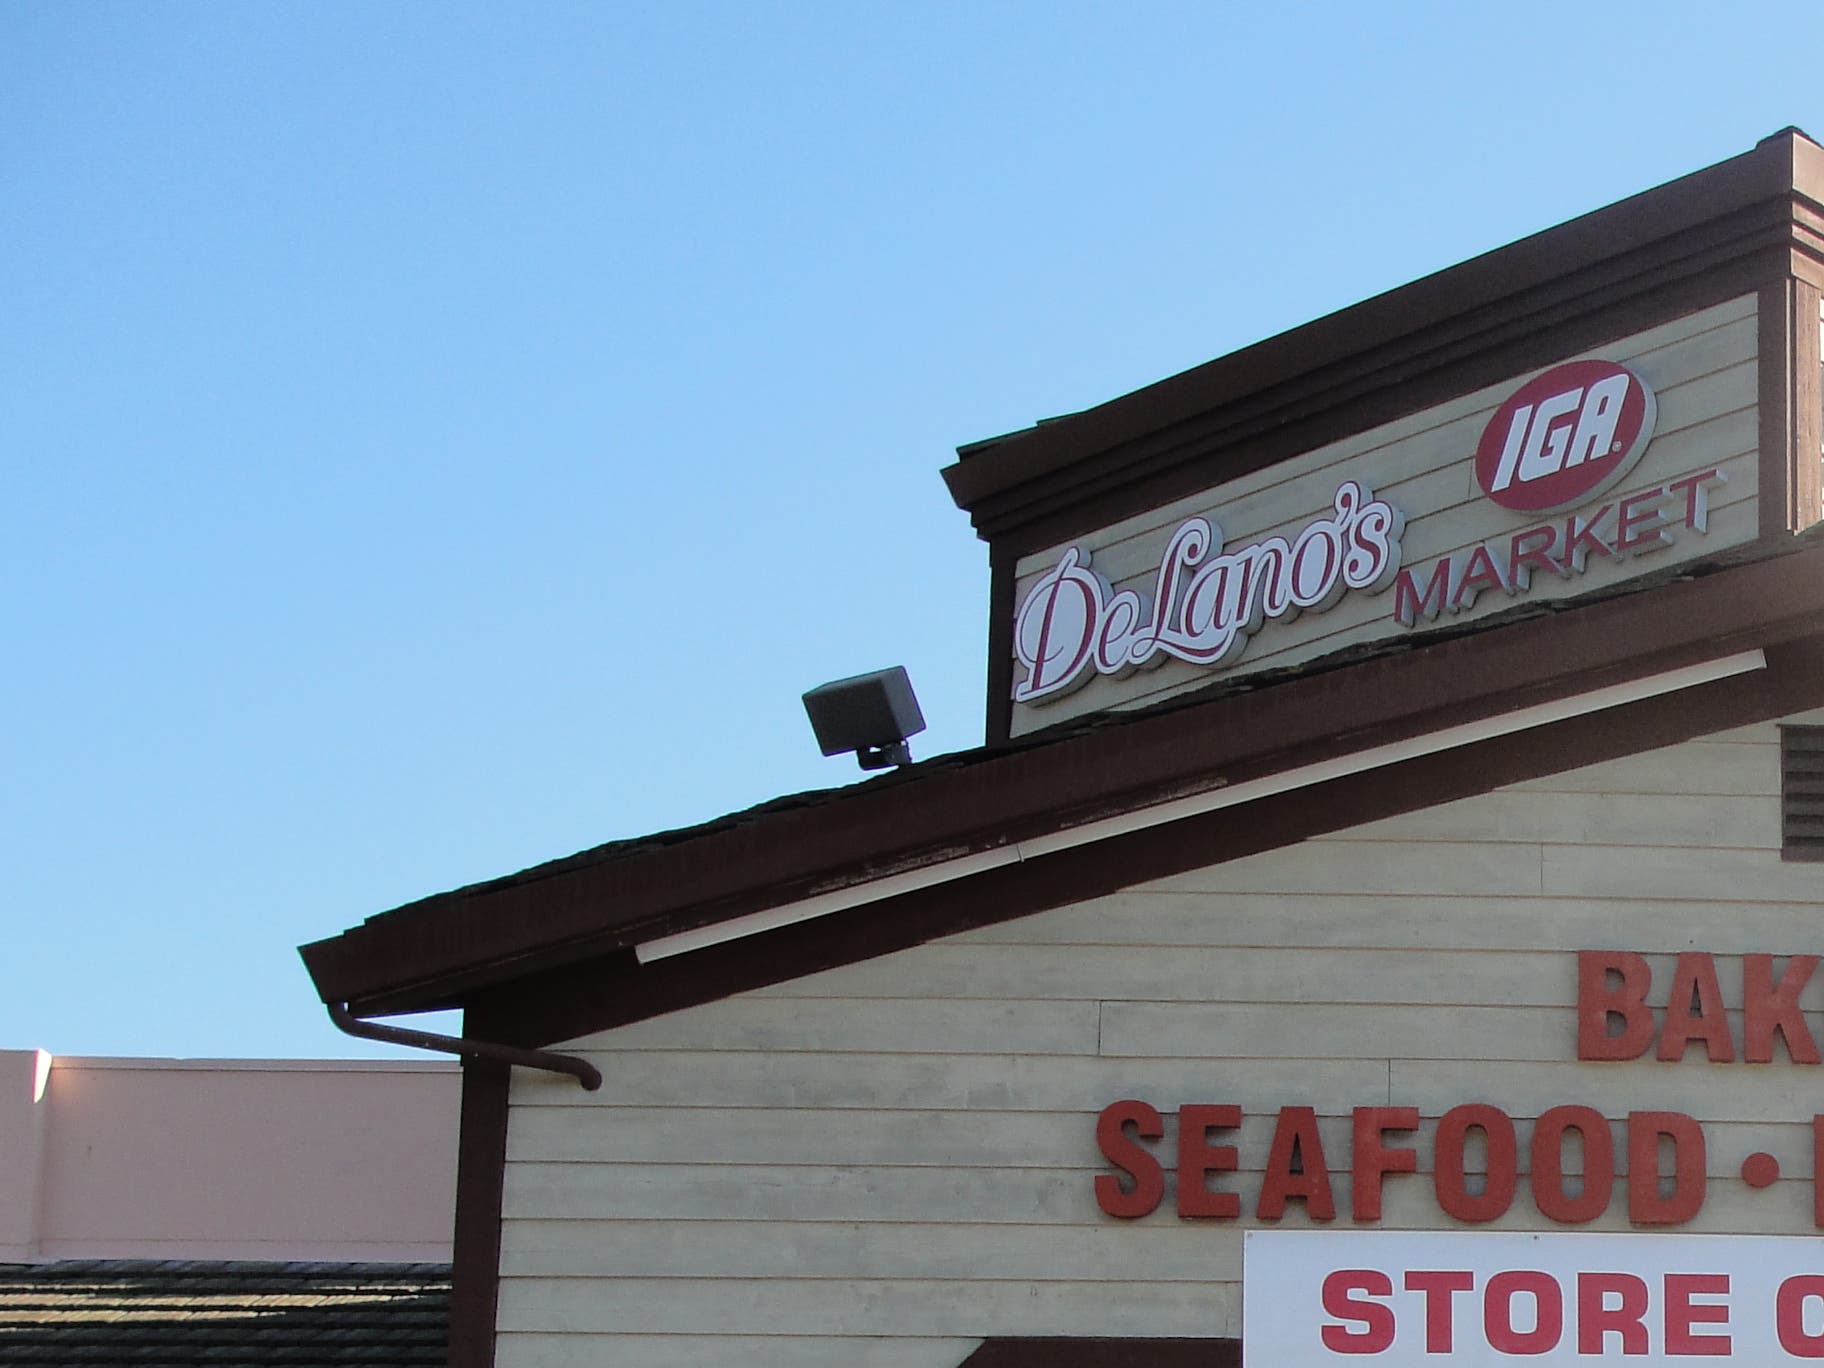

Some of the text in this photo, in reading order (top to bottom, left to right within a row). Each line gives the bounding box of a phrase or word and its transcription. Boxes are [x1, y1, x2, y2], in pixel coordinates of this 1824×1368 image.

[1491, 373, 1630, 493] IGA
[1012, 481, 1395, 703] DeLano's
[1394, 468, 1728, 626] MARKET
[1094, 1100, 1707, 1226] SEAFOOD
[1320, 1269, 1732, 1357] STORE
